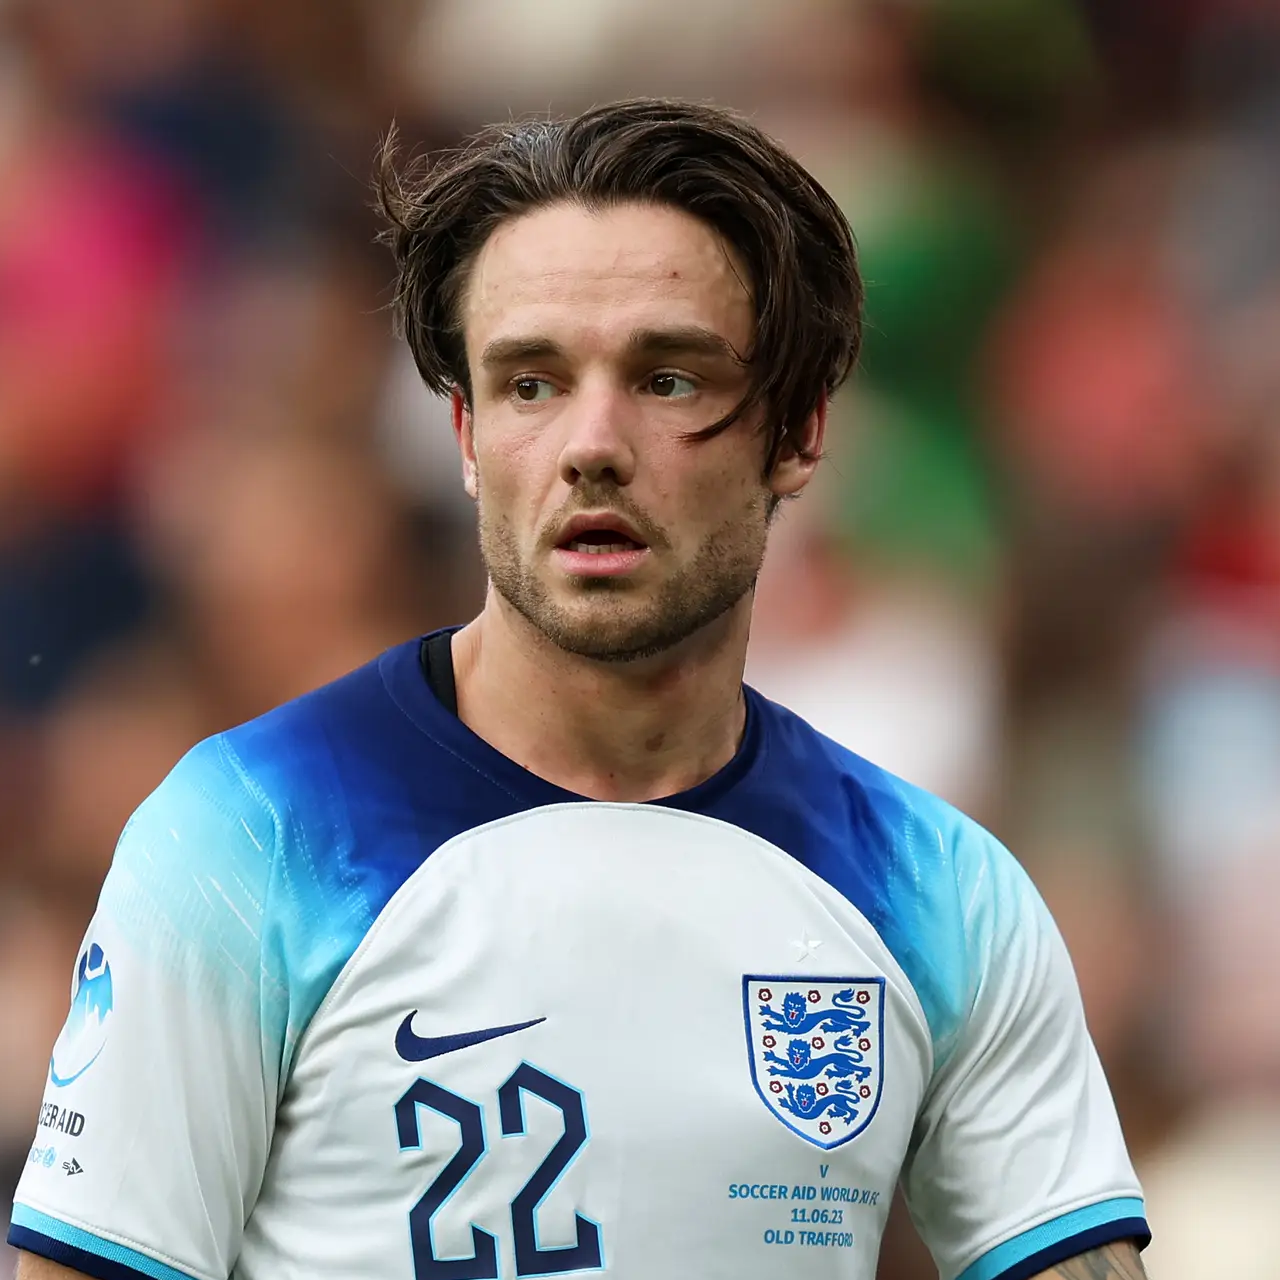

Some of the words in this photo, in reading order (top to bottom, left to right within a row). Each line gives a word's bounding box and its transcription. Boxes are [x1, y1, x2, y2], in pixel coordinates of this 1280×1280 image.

[820, 1164, 829, 1178] V
[728, 1184, 788, 1200] SOCCER
[791, 1185, 817, 1201] AID
[820, 1187, 859, 1203] WORLD
[858, 1190, 870, 1205] XI
[791, 1208, 844, 1224] 11.06.23
[764, 1229, 795, 1245] OLD
[798, 1231, 854, 1248] TRAFFORD
